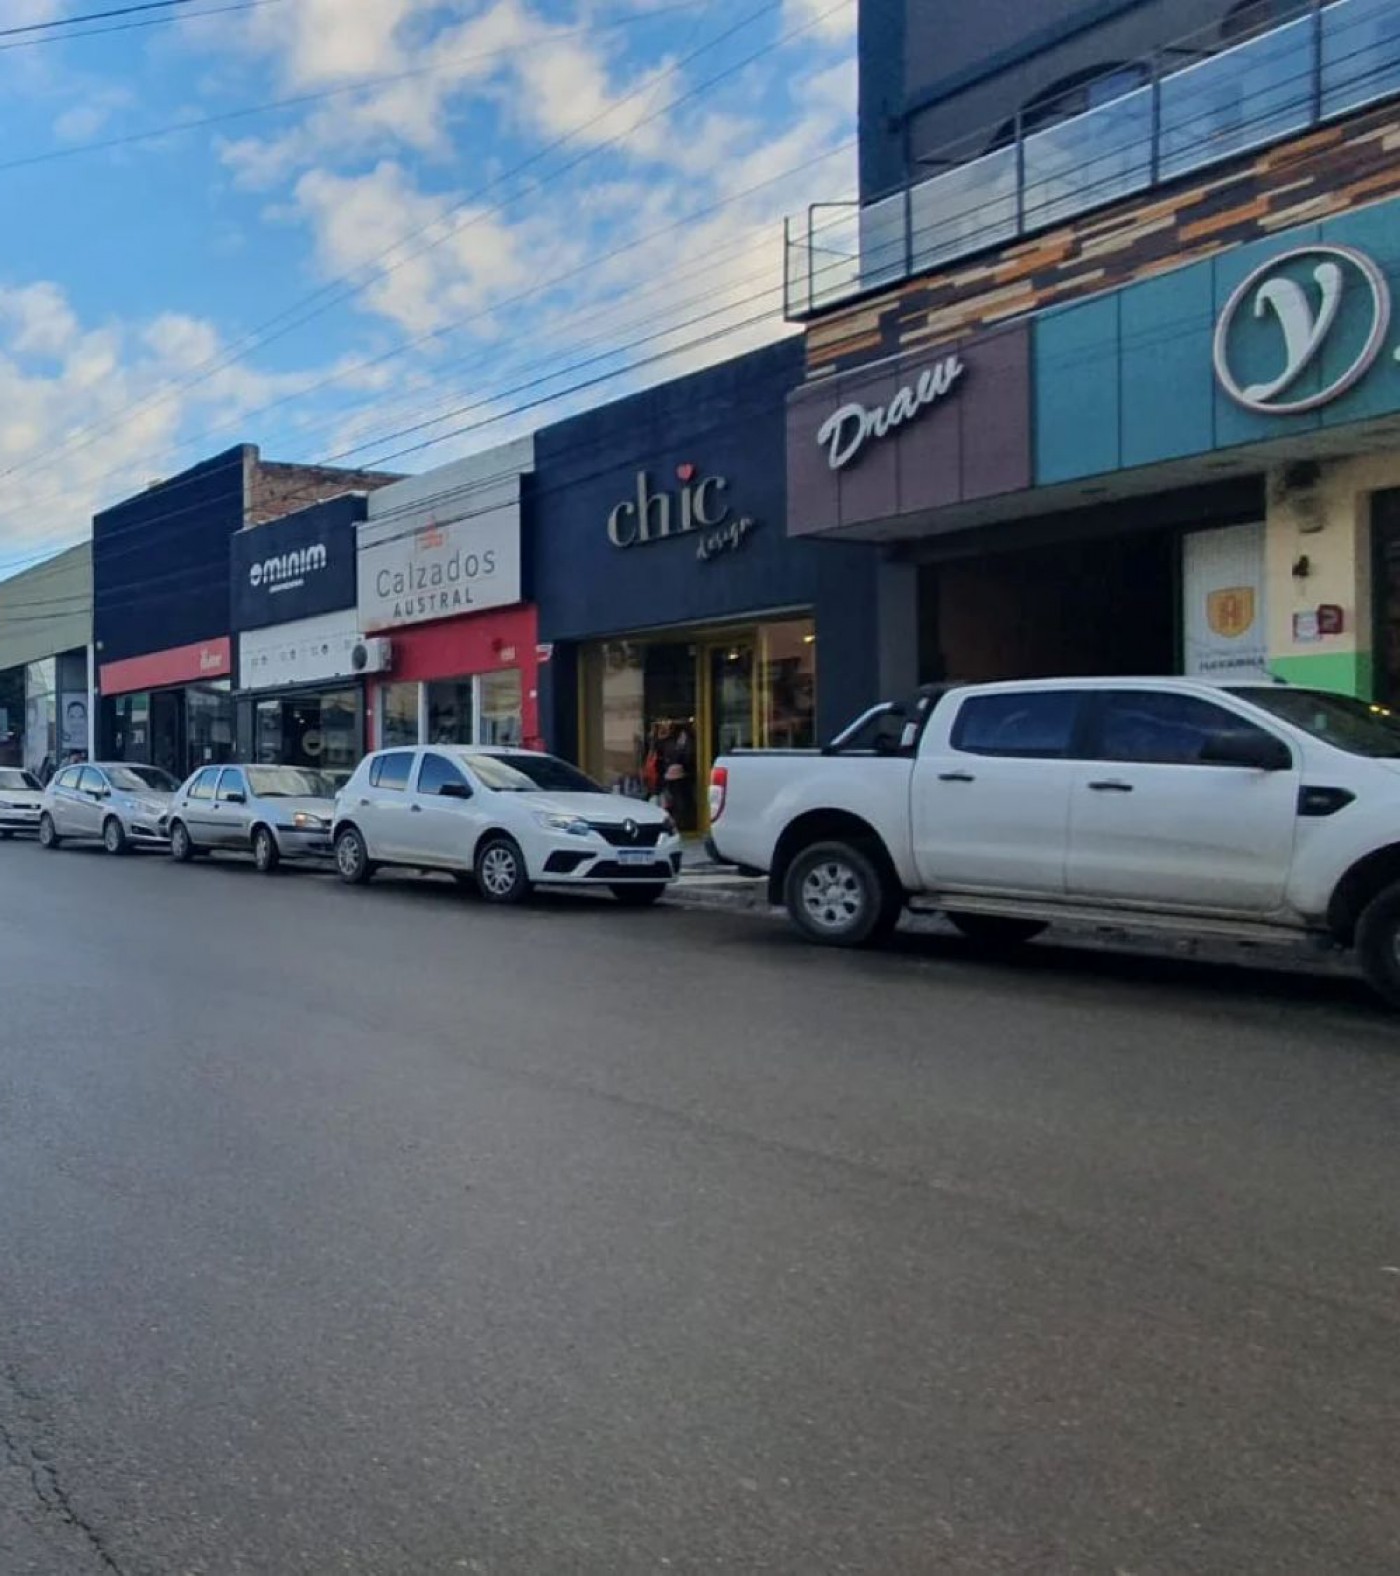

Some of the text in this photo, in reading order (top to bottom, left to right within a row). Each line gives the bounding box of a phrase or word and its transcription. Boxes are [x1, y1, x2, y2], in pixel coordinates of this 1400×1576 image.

[817, 356, 964, 470] Draw
[607, 463, 728, 547] chic
[376, 549, 496, 598] Calzados
[393, 586, 474, 618] AUSTRAL
